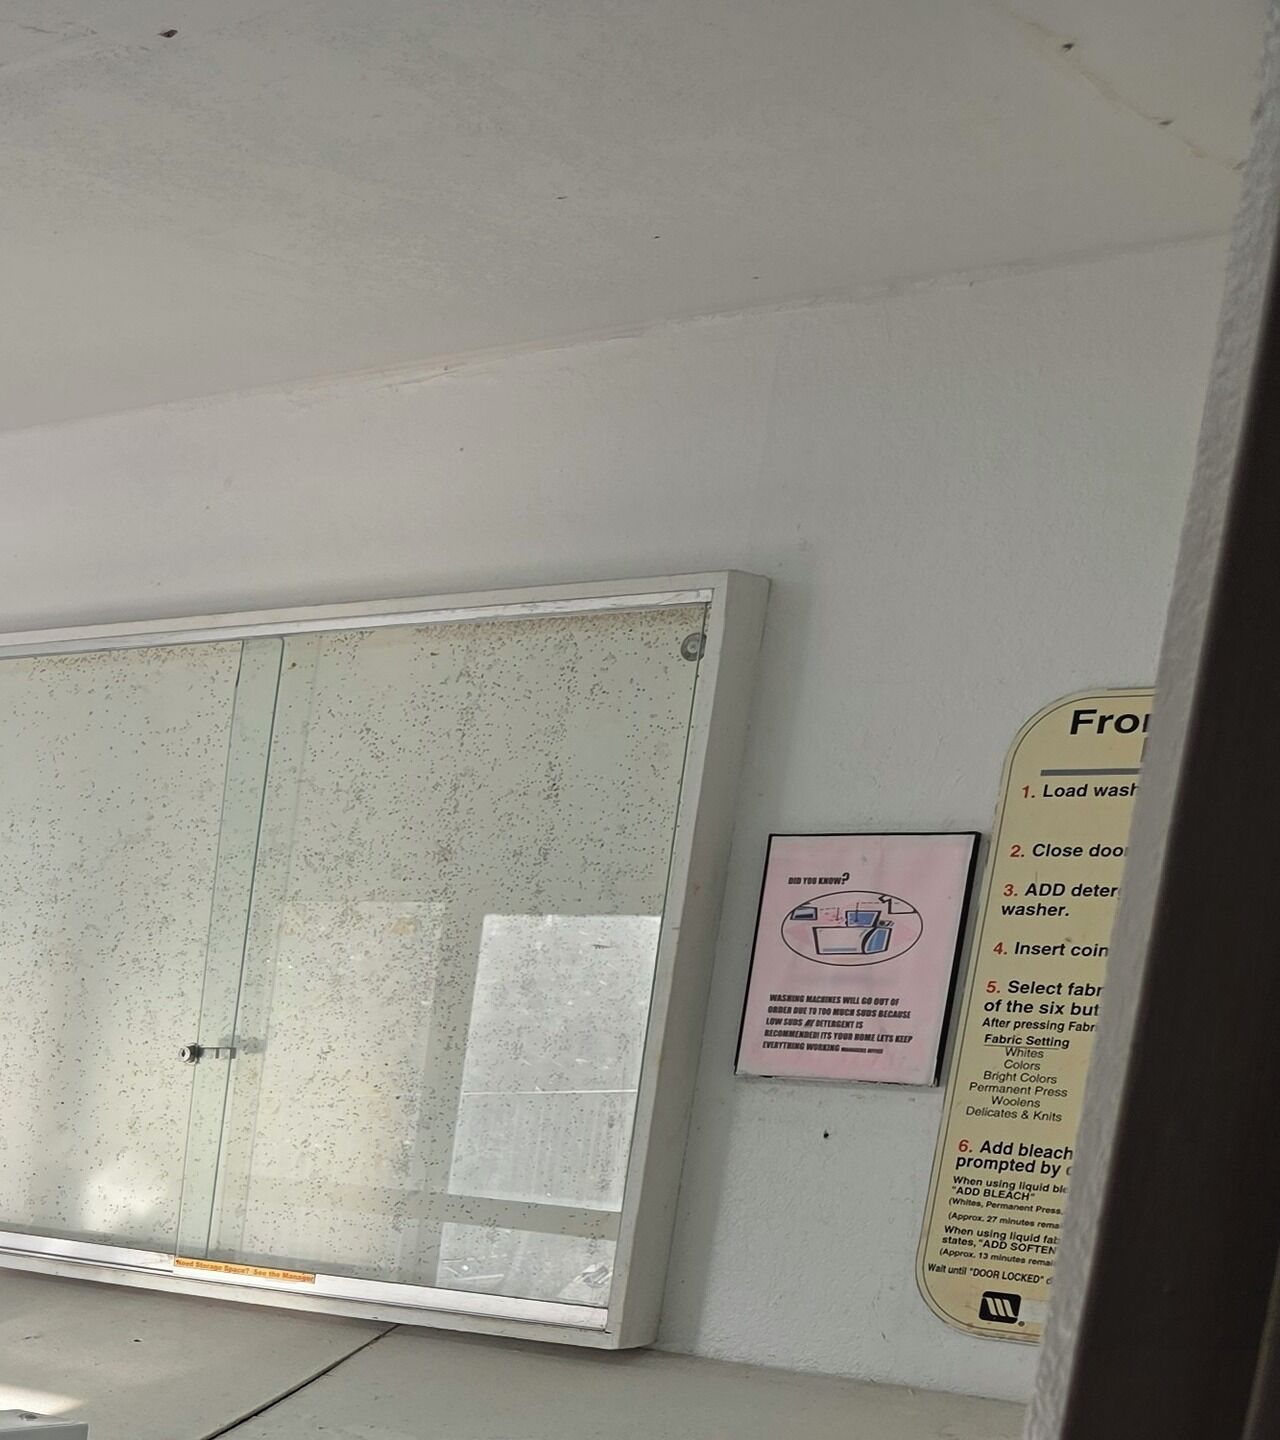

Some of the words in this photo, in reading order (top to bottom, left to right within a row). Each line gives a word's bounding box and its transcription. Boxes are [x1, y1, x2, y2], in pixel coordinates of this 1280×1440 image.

[1022, 785, 1035, 798] 1.
[1043, 784, 1088, 797] Load
[1010, 844, 1024, 857] 2.
[1032, 843, 1083, 857] Close
[1003, 883, 1018, 897] 3.
[1024, 883, 1066, 896] ADD
[1071, 883, 1121, 900] deter
[1001, 903, 1069, 916] washer.
[993, 942, 1007, 955] 4.
[1014, 942, 1065, 956] Insert
[986, 981, 1000, 994] 5.
[1007, 980, 1062, 995] Select
[770, 994, 805, 1002] WASHING
[806, 995, 841, 1004] MACHINES
[842, 996, 860, 1004] WILL
[861, 997, 872, 1005] GO
[890, 998, 900, 1006] OF
[984, 1000, 1002, 1012] of
[1006, 1000, 1034, 1013] the
[1039, 1002, 1065, 1015] six
[982, 1017, 1010, 1028] After
[1013, 1020, 1064, 1033] pressing
[984, 1034, 1022, 1045] Fabric
[1026, 1036, 1070, 1049] Setting
[1005, 1048, 1044, 1058] Whites
[1004, 1059, 1041, 1071] Colors
[983, 1071, 1016, 1083] Bright
[1020, 1073, 1058, 1084] Colors
[969, 1082, 1031, 1094] Permanent
[1034, 1086, 1068, 1097] Press
[991, 1096, 1041, 1108] Woolens
[966, 1106, 1018, 1118] Delicates
[1021, 1110, 1029, 1119] &
[1033, 1112, 1062, 1122] Knits
[959, 1139, 972, 1153] 6.
[980, 1140, 1014, 1155] Add
[955, 1156, 1036, 1174] prompted
[1040, 1161, 1062, 1178] by
[953, 1176, 982, 1186] When
[986, 1179, 1016, 1190] using
[1019, 1181, 1049, 1192] liquid
[944, 1225, 974, 1236] When
[976, 1230, 1006, 1239] using
[1010, 1232, 1041, 1243] liquid
[942, 1236, 976, 1248] states,
[928, 1263, 946, 1273] Wait
[948, 1266, 967, 1275] until
